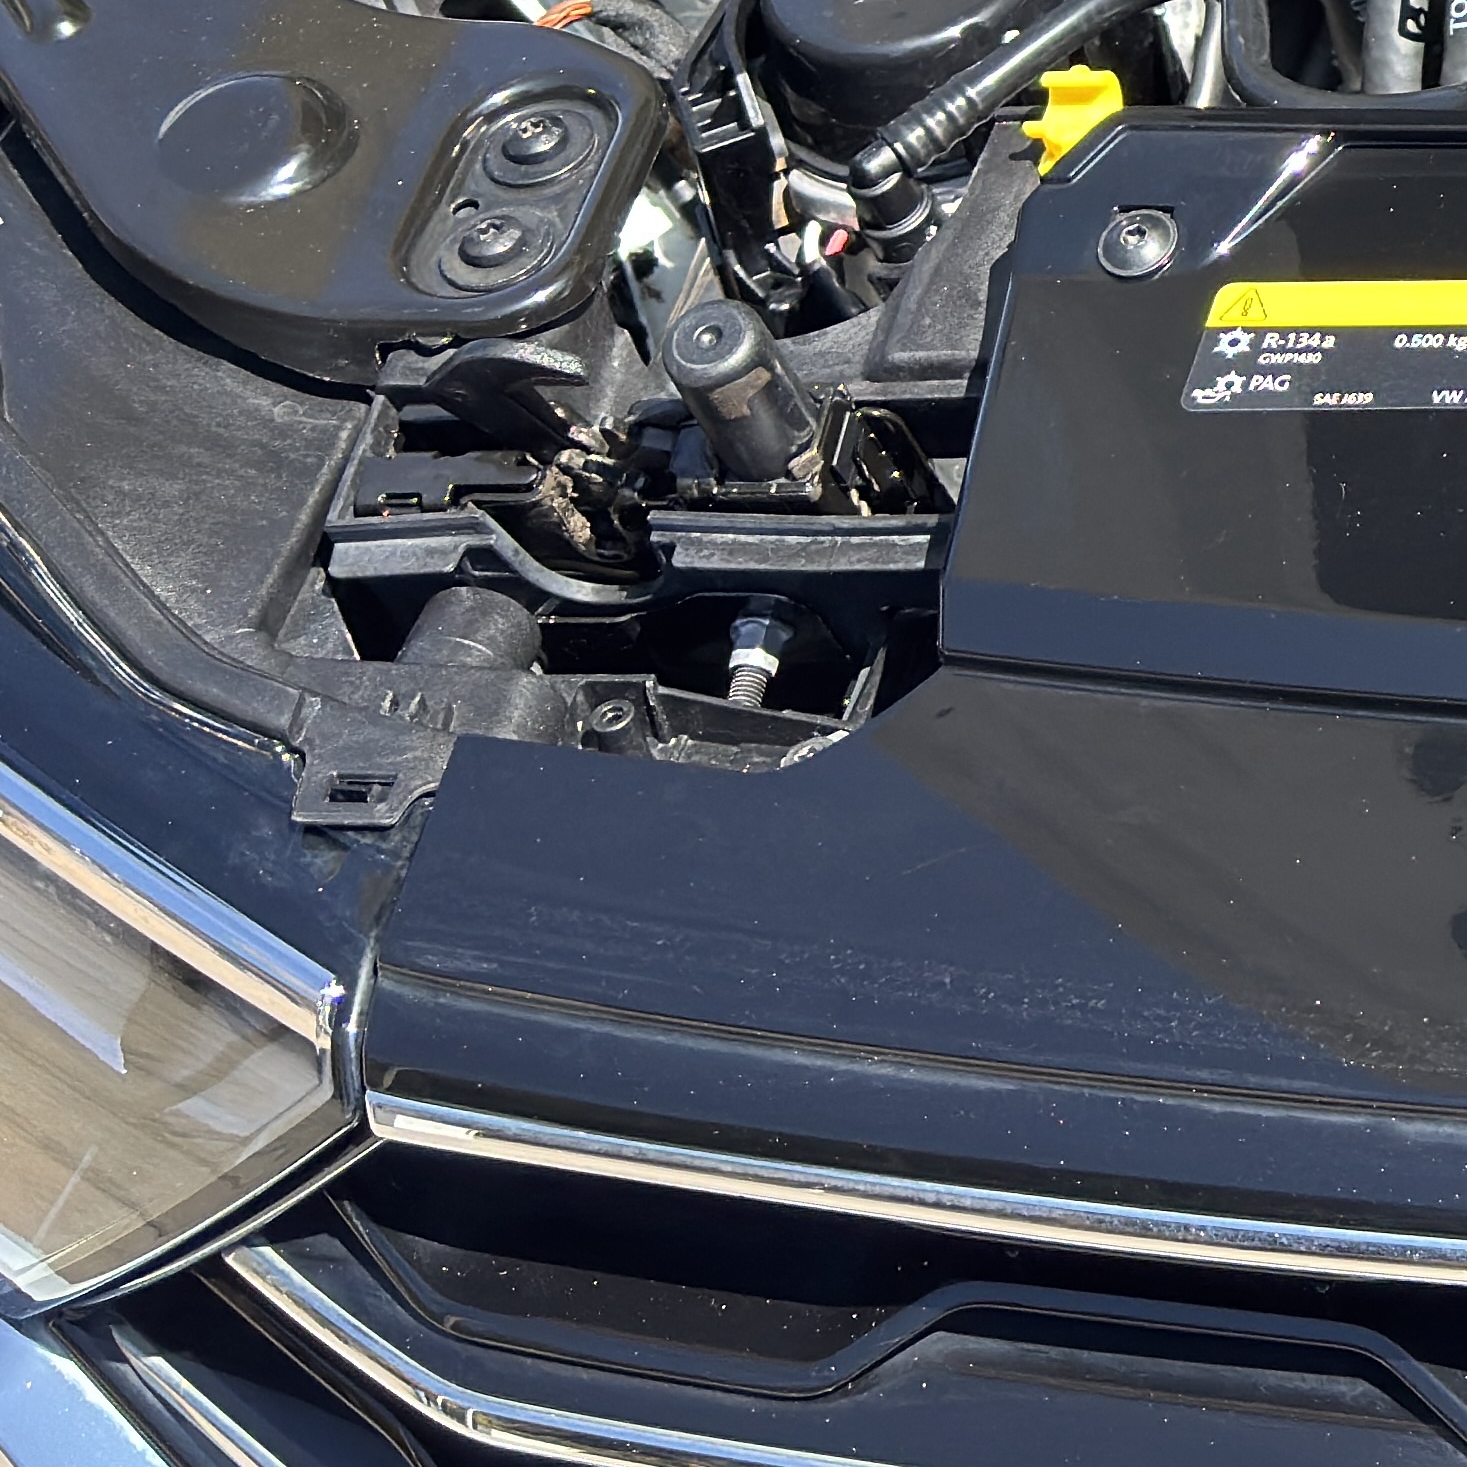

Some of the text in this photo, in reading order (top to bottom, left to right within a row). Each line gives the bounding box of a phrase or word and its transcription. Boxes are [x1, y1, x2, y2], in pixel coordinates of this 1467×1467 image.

[1249, 374, 1291, 391] PAG
[1313, 392, 1341, 406] SAE
[1432, 391, 1462, 404] VW
